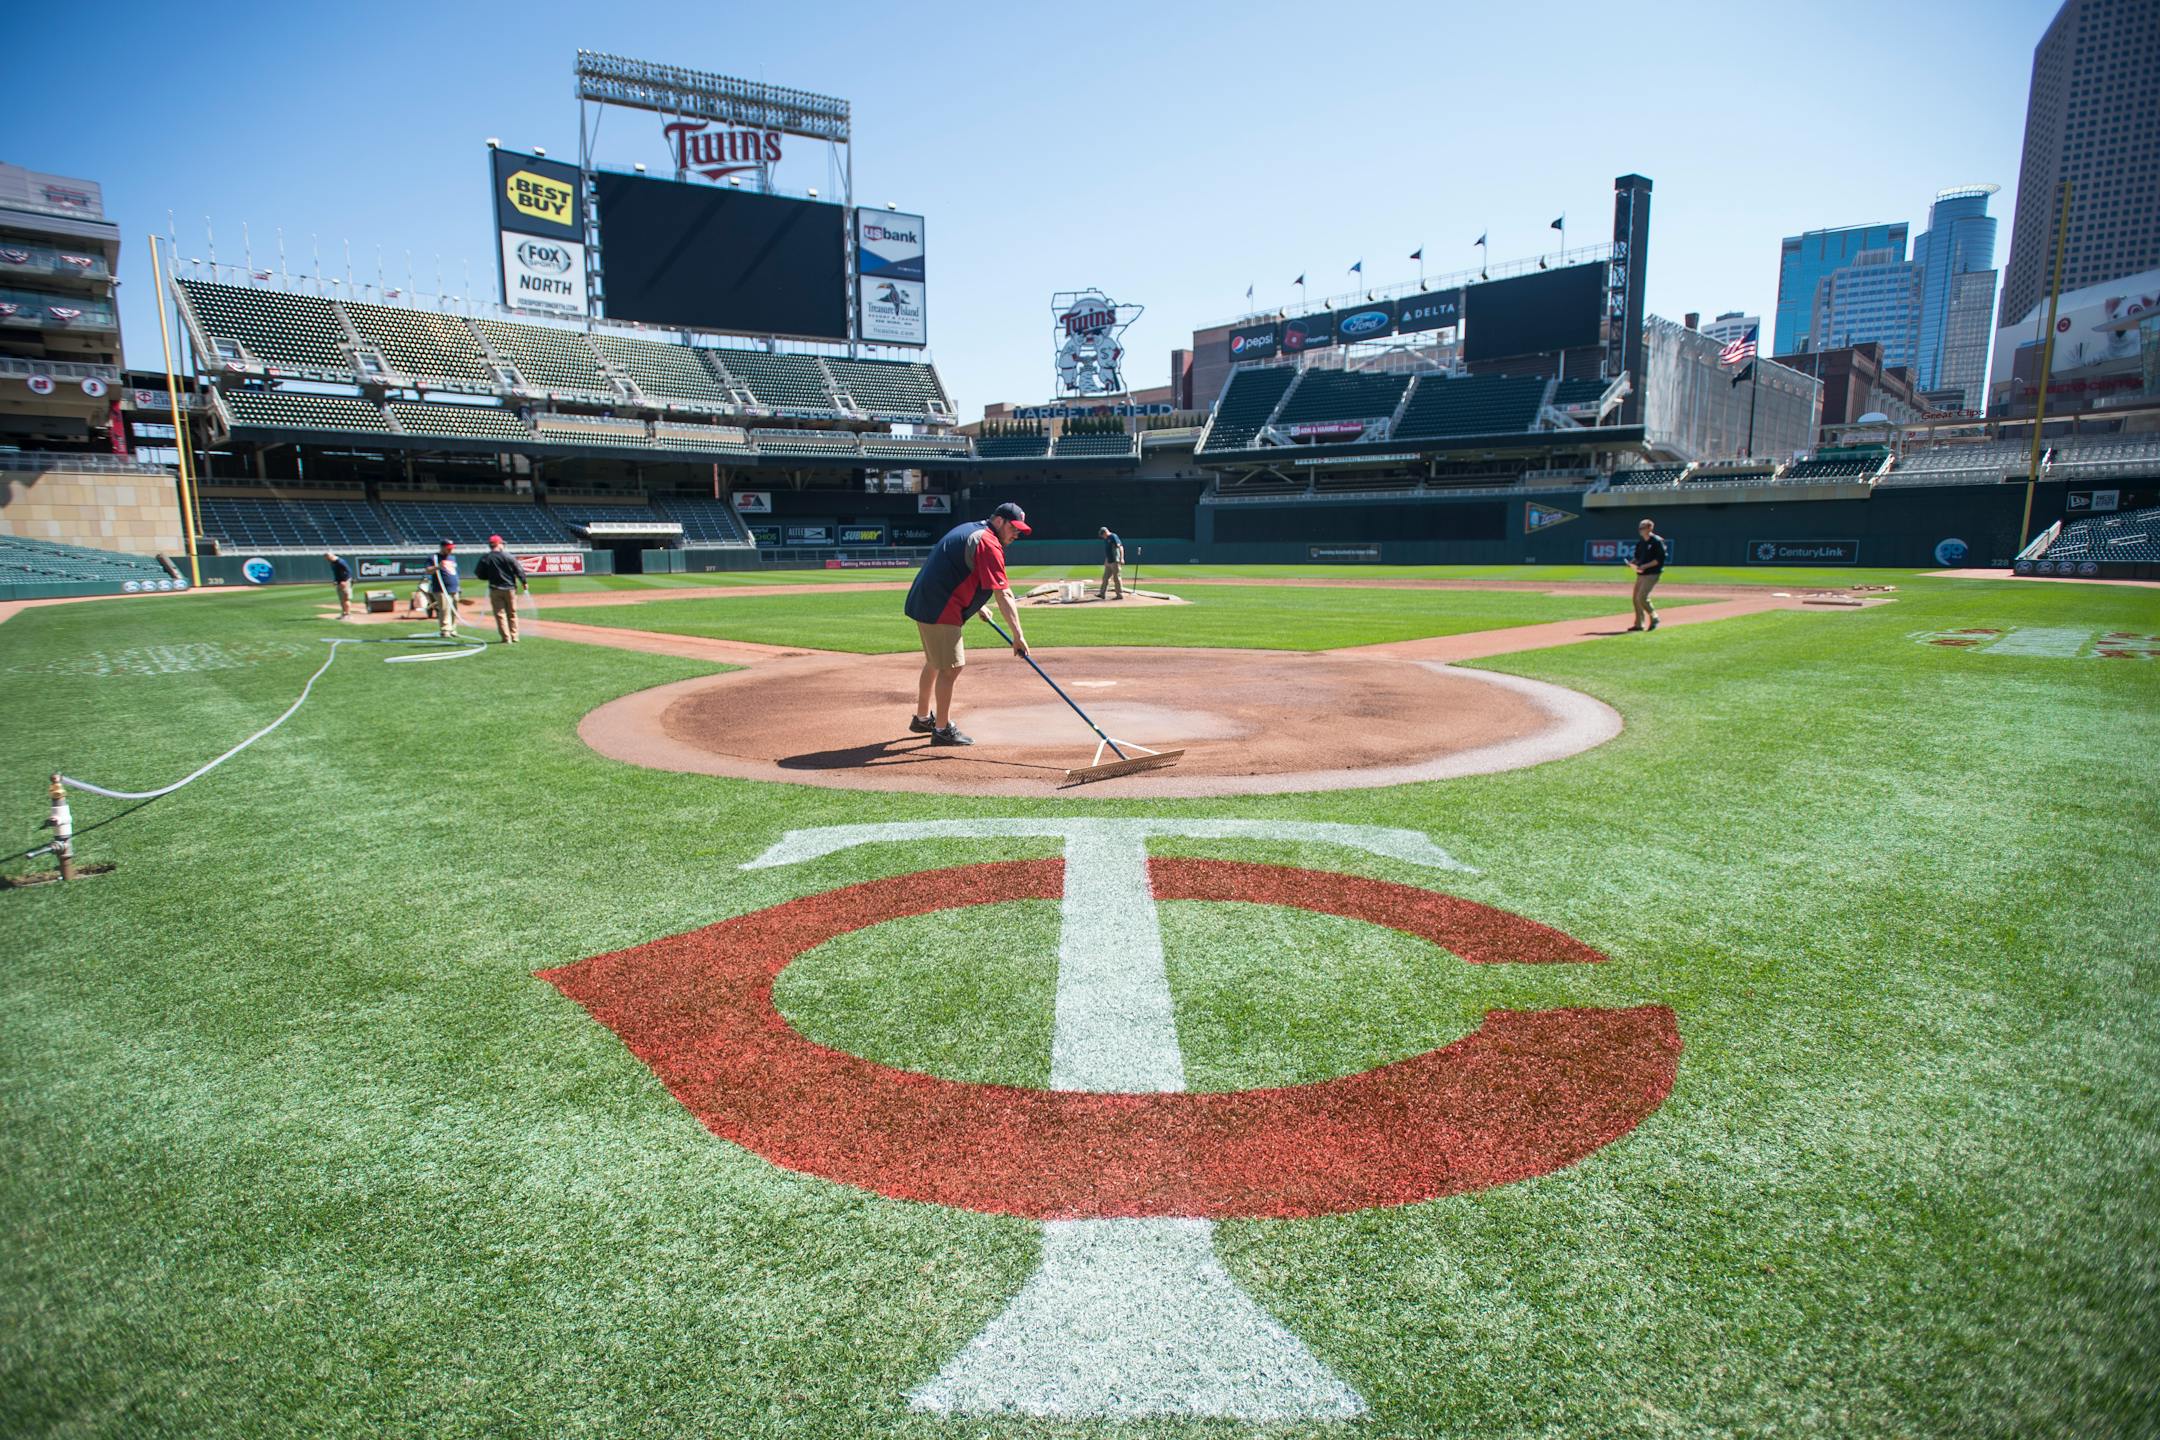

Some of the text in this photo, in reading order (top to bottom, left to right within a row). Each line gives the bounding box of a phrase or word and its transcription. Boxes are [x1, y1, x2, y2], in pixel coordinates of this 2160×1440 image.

[664, 119, 782, 175] Twins
[516, 178, 570, 204] BEST
[518, 193, 565, 216] BUY
[528, 245, 560, 263] FOX
[520, 274, 572, 295] NORTH
[867, 302, 919, 317] Treasure Island
[1415, 303, 1455, 319] DELTA
[1060, 309, 1116, 338] Twins
[1350, 317, 1378, 331] Ford
[1245, 333, 1273, 349] pepsi
[1014, 404, 1173, 419] TARGET FIELD
[1921, 408, 1984, 420] Great Clips
[843, 530, 882, 540] SUBWAY
[1779, 547, 1843, 558] CenturyLink
[361, 561, 400, 576] Cargill
